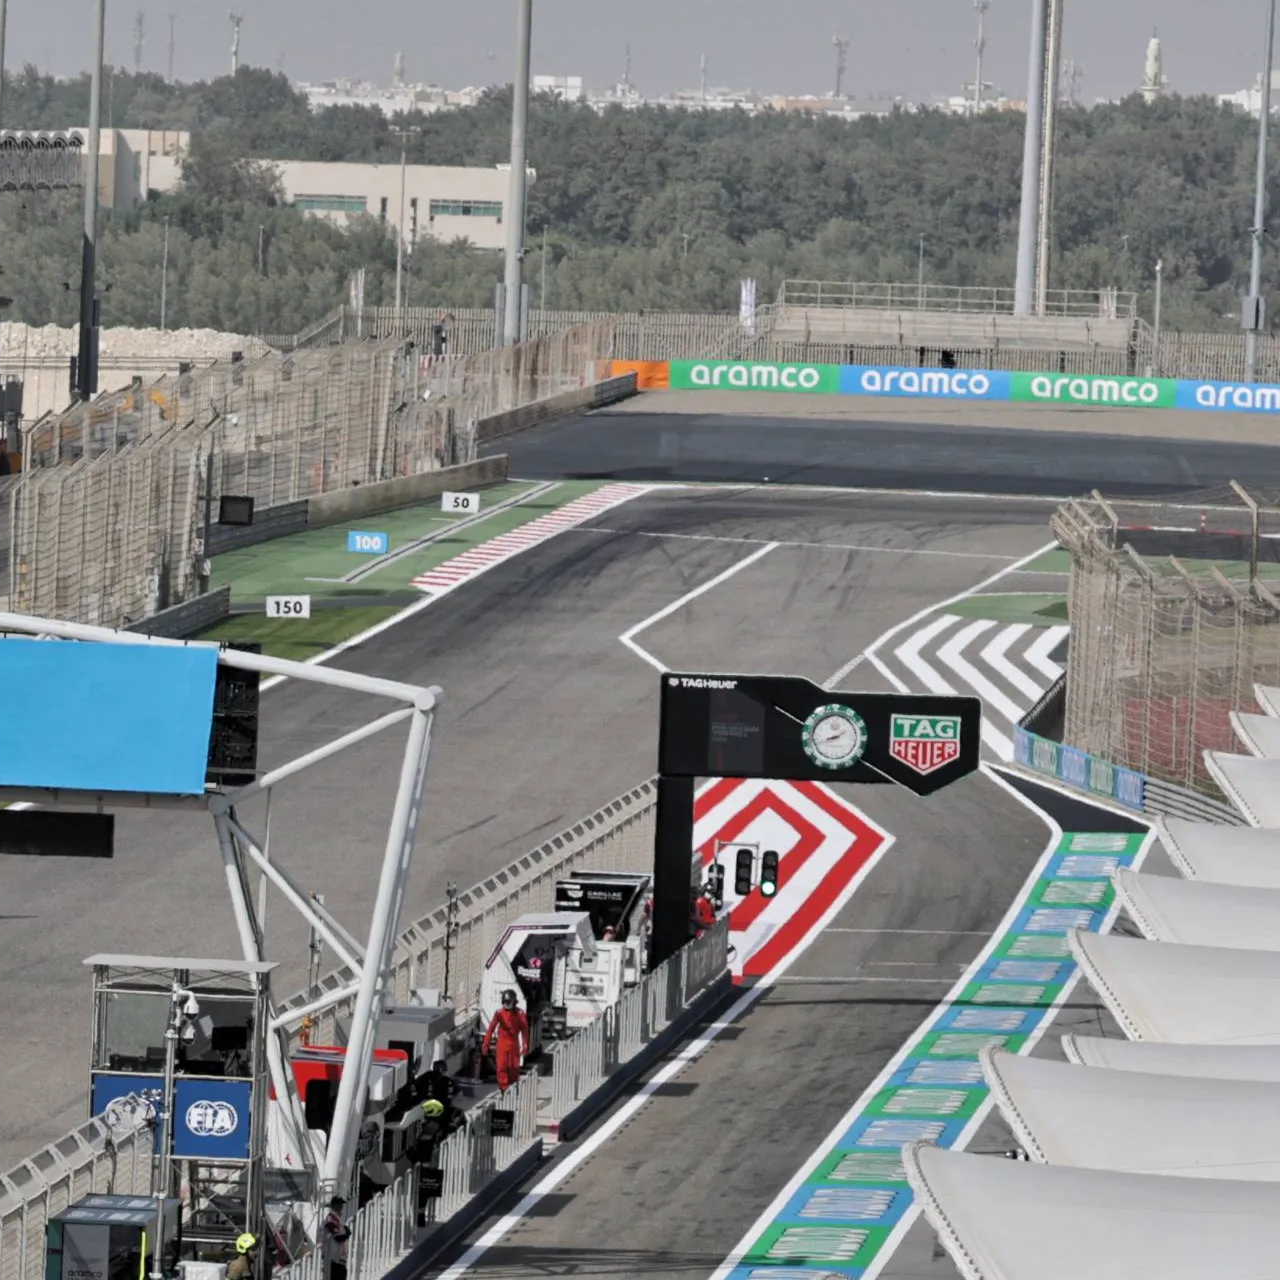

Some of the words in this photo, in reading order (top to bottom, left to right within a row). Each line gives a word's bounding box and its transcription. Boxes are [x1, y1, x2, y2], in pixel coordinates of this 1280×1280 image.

[690, 364, 820, 388] aramco
[861, 370, 989, 395] aramco
[1031, 376, 1159, 402] aramco
[452, 497, 469, 509] 50
[355, 535, 382, 550] 100
[274, 601, 302, 614] 150
[896, 718, 955, 738] TAG
[893, 741, 957, 770] HEUER
[189, 1107, 232, 1129] FIA
